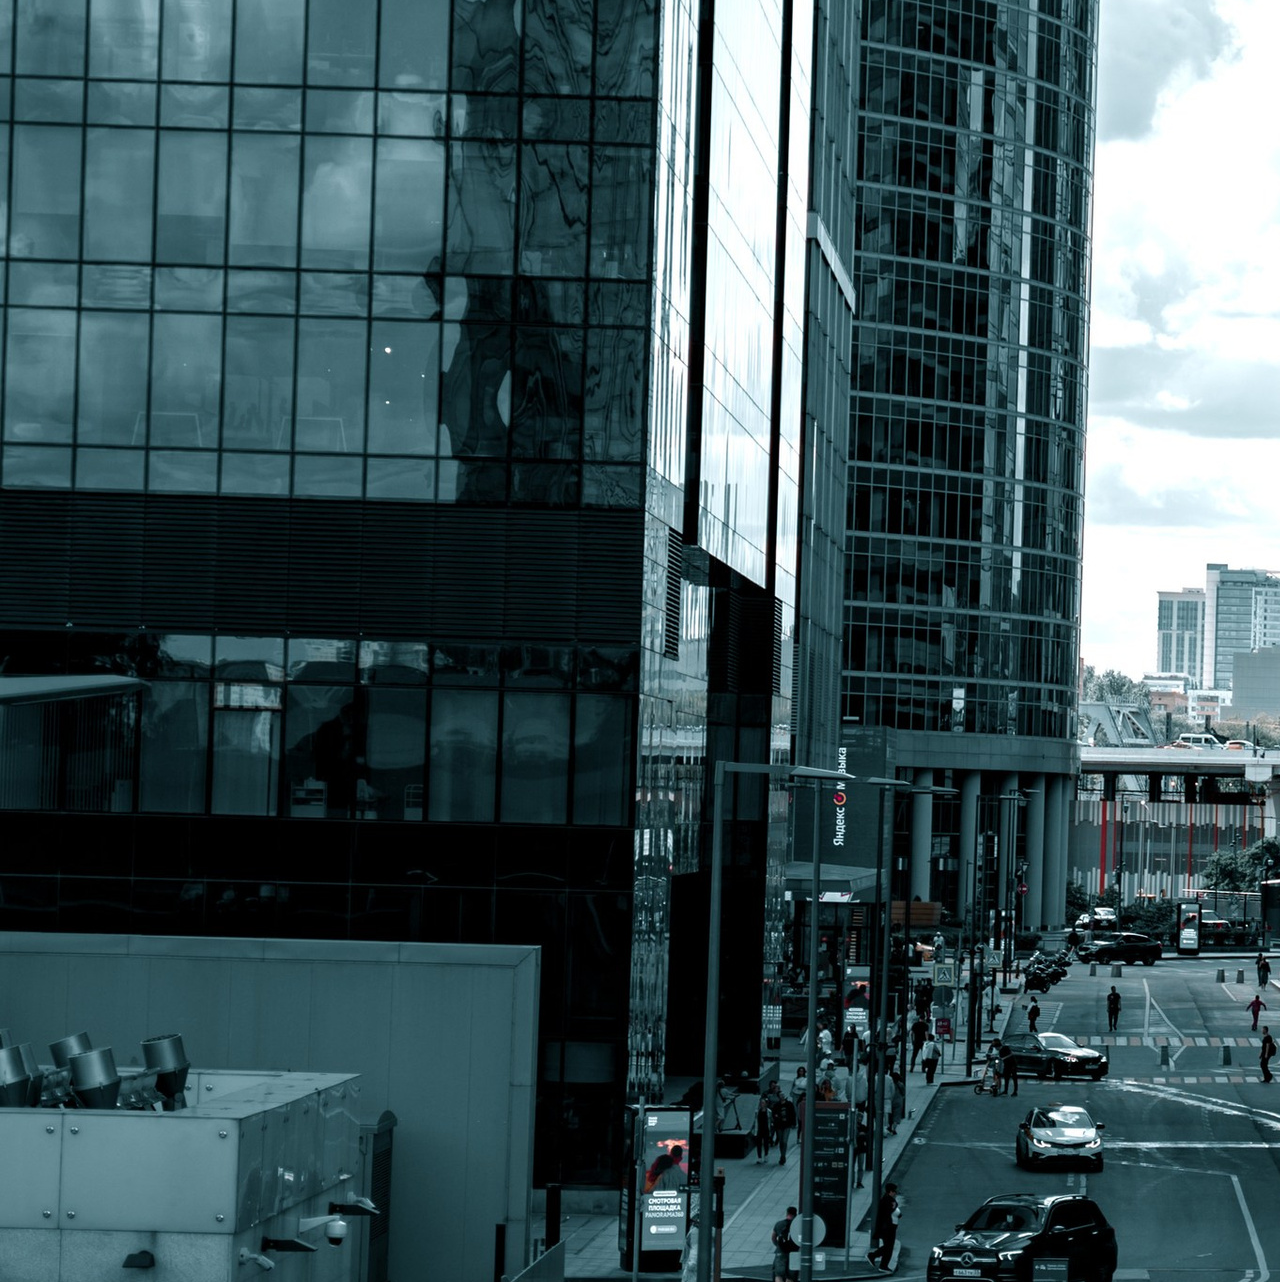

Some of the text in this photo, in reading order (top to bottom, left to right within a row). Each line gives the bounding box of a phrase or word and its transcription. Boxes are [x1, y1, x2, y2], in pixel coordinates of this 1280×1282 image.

[832, 746, 847, 846] Яндекс Мзыка
[648, 1204, 681, 1212] ПЛОЩАДКА
